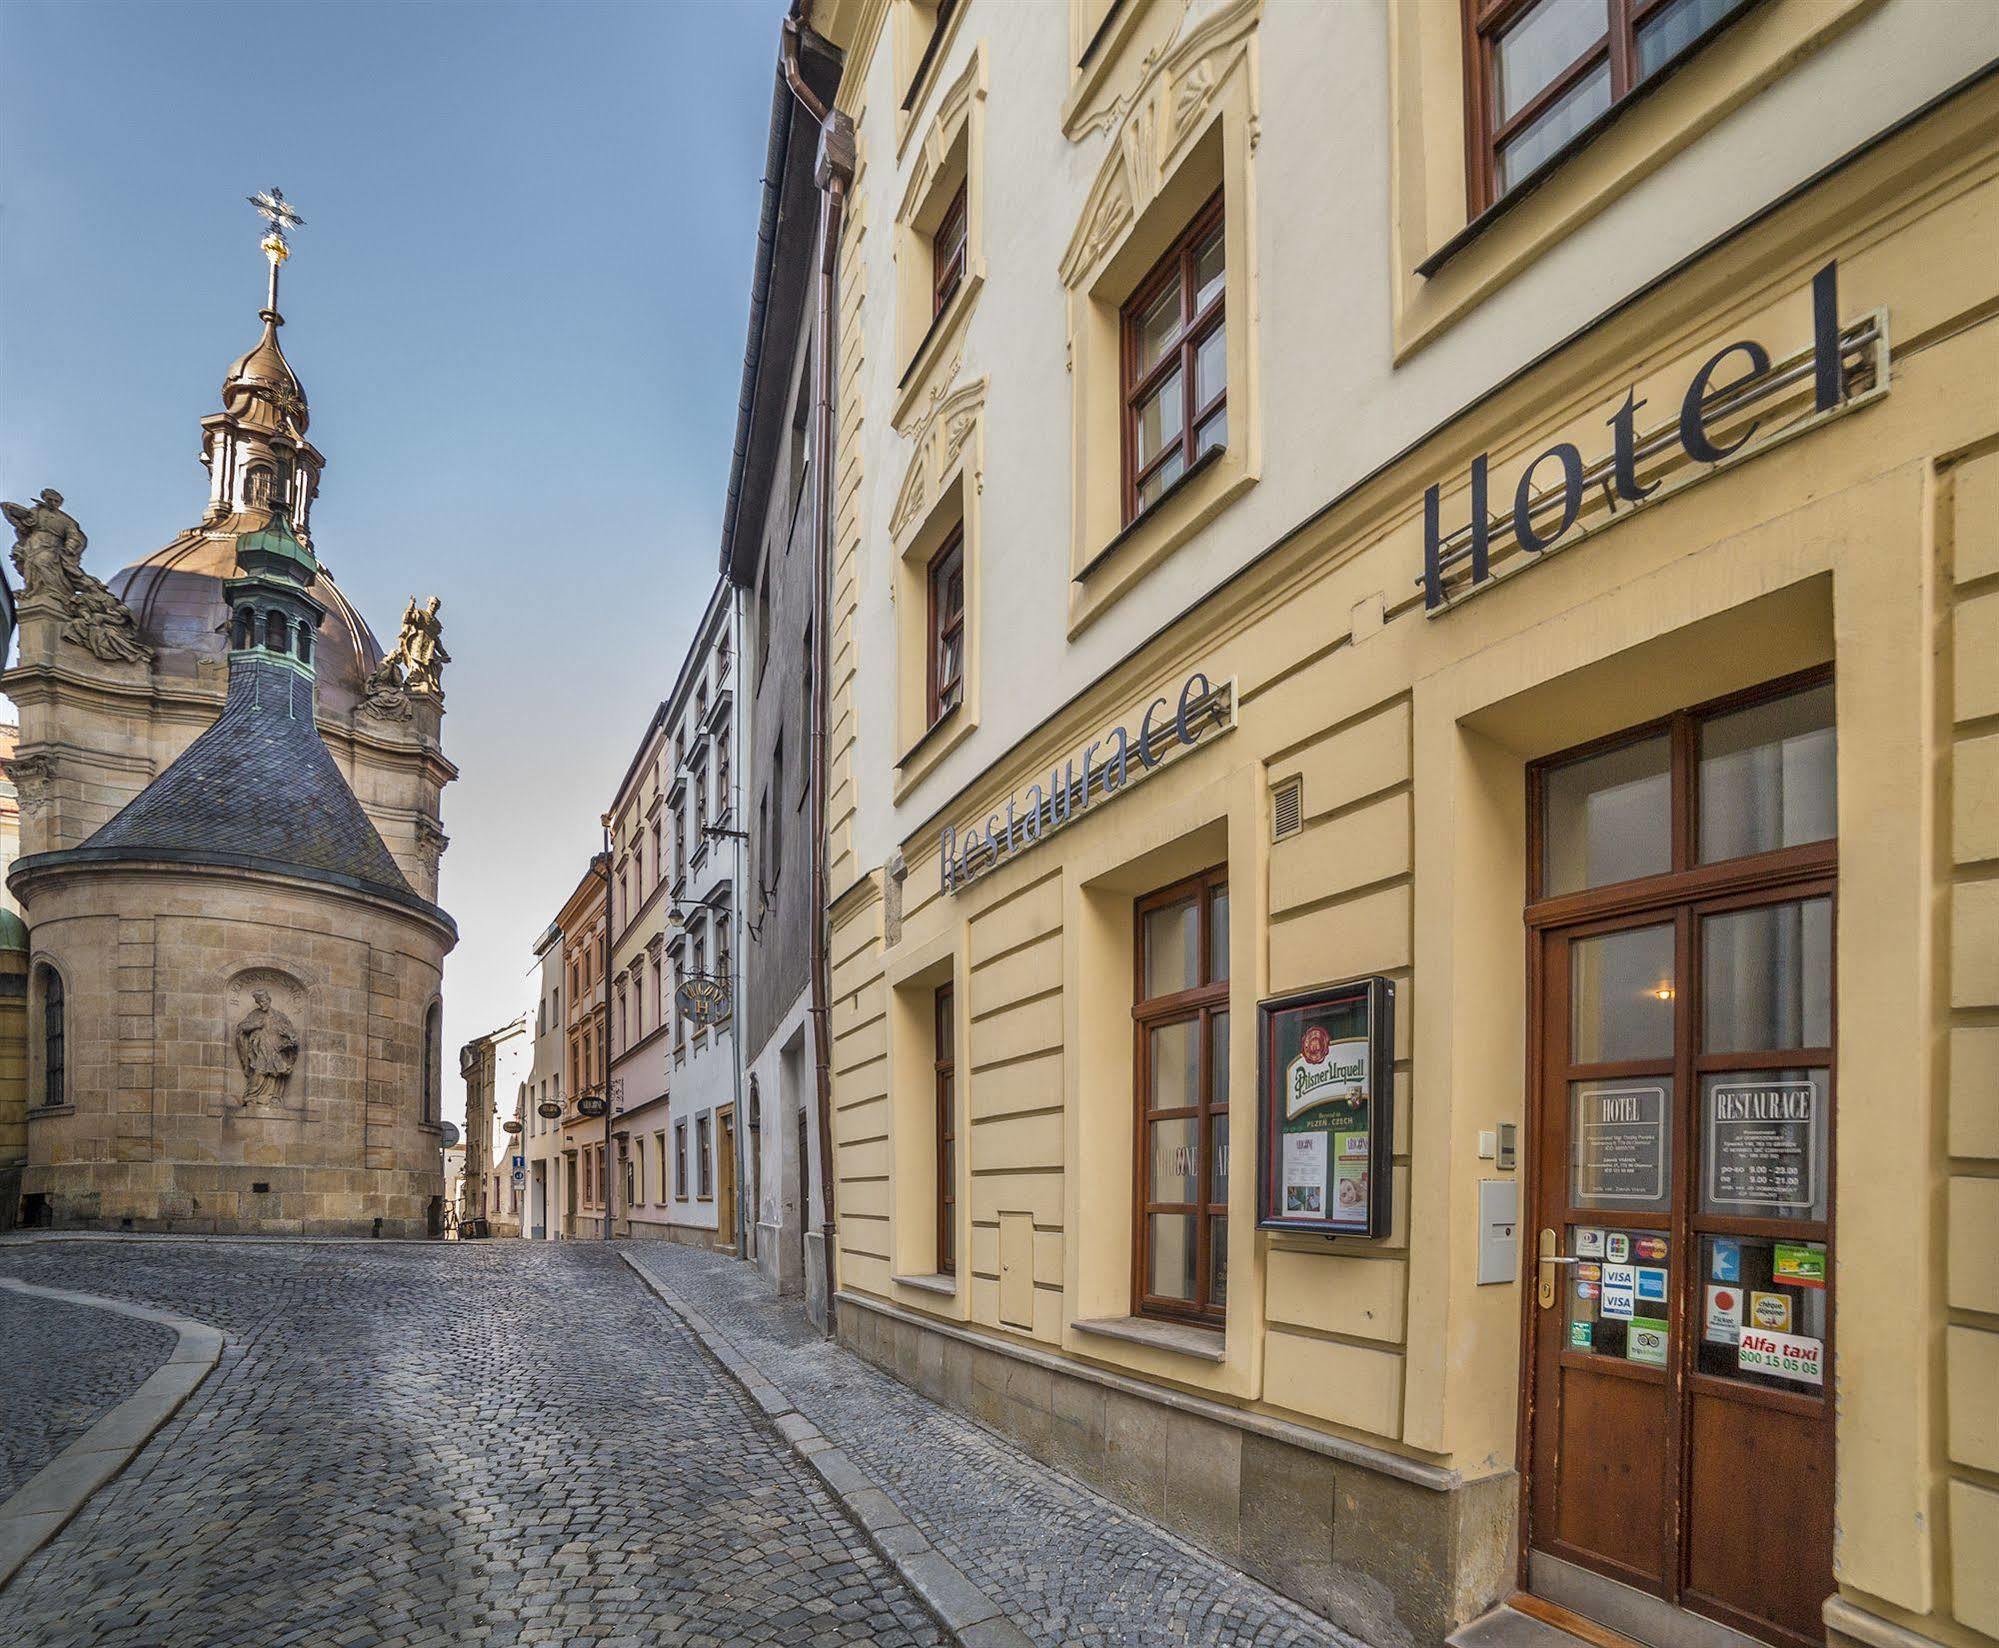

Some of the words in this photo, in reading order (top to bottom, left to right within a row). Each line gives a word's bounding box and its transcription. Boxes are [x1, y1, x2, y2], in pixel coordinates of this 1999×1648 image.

[1424, 259, 1841, 609] Hotel
[940, 673, 1210, 897] Restaurace
[1295, 1066, 1329, 1100] Pilsner
[1328, 1059, 1364, 1085] Urquell
[1603, 1098, 1640, 1122] HOTEL
[1717, 1091, 1809, 1120] RESTAURACE
[1608, 1271, 1632, 1283] VISA
[1607, 1296, 1631, 1308] VISA
[1741, 1335, 1776, 1354] Alfa
[1783, 1343, 1818, 1361] taxi
[1765, 1355, 1780, 1368] 15
[1783, 1358, 1799, 1371] 05
[1802, 1362, 1818, 1375] 05
